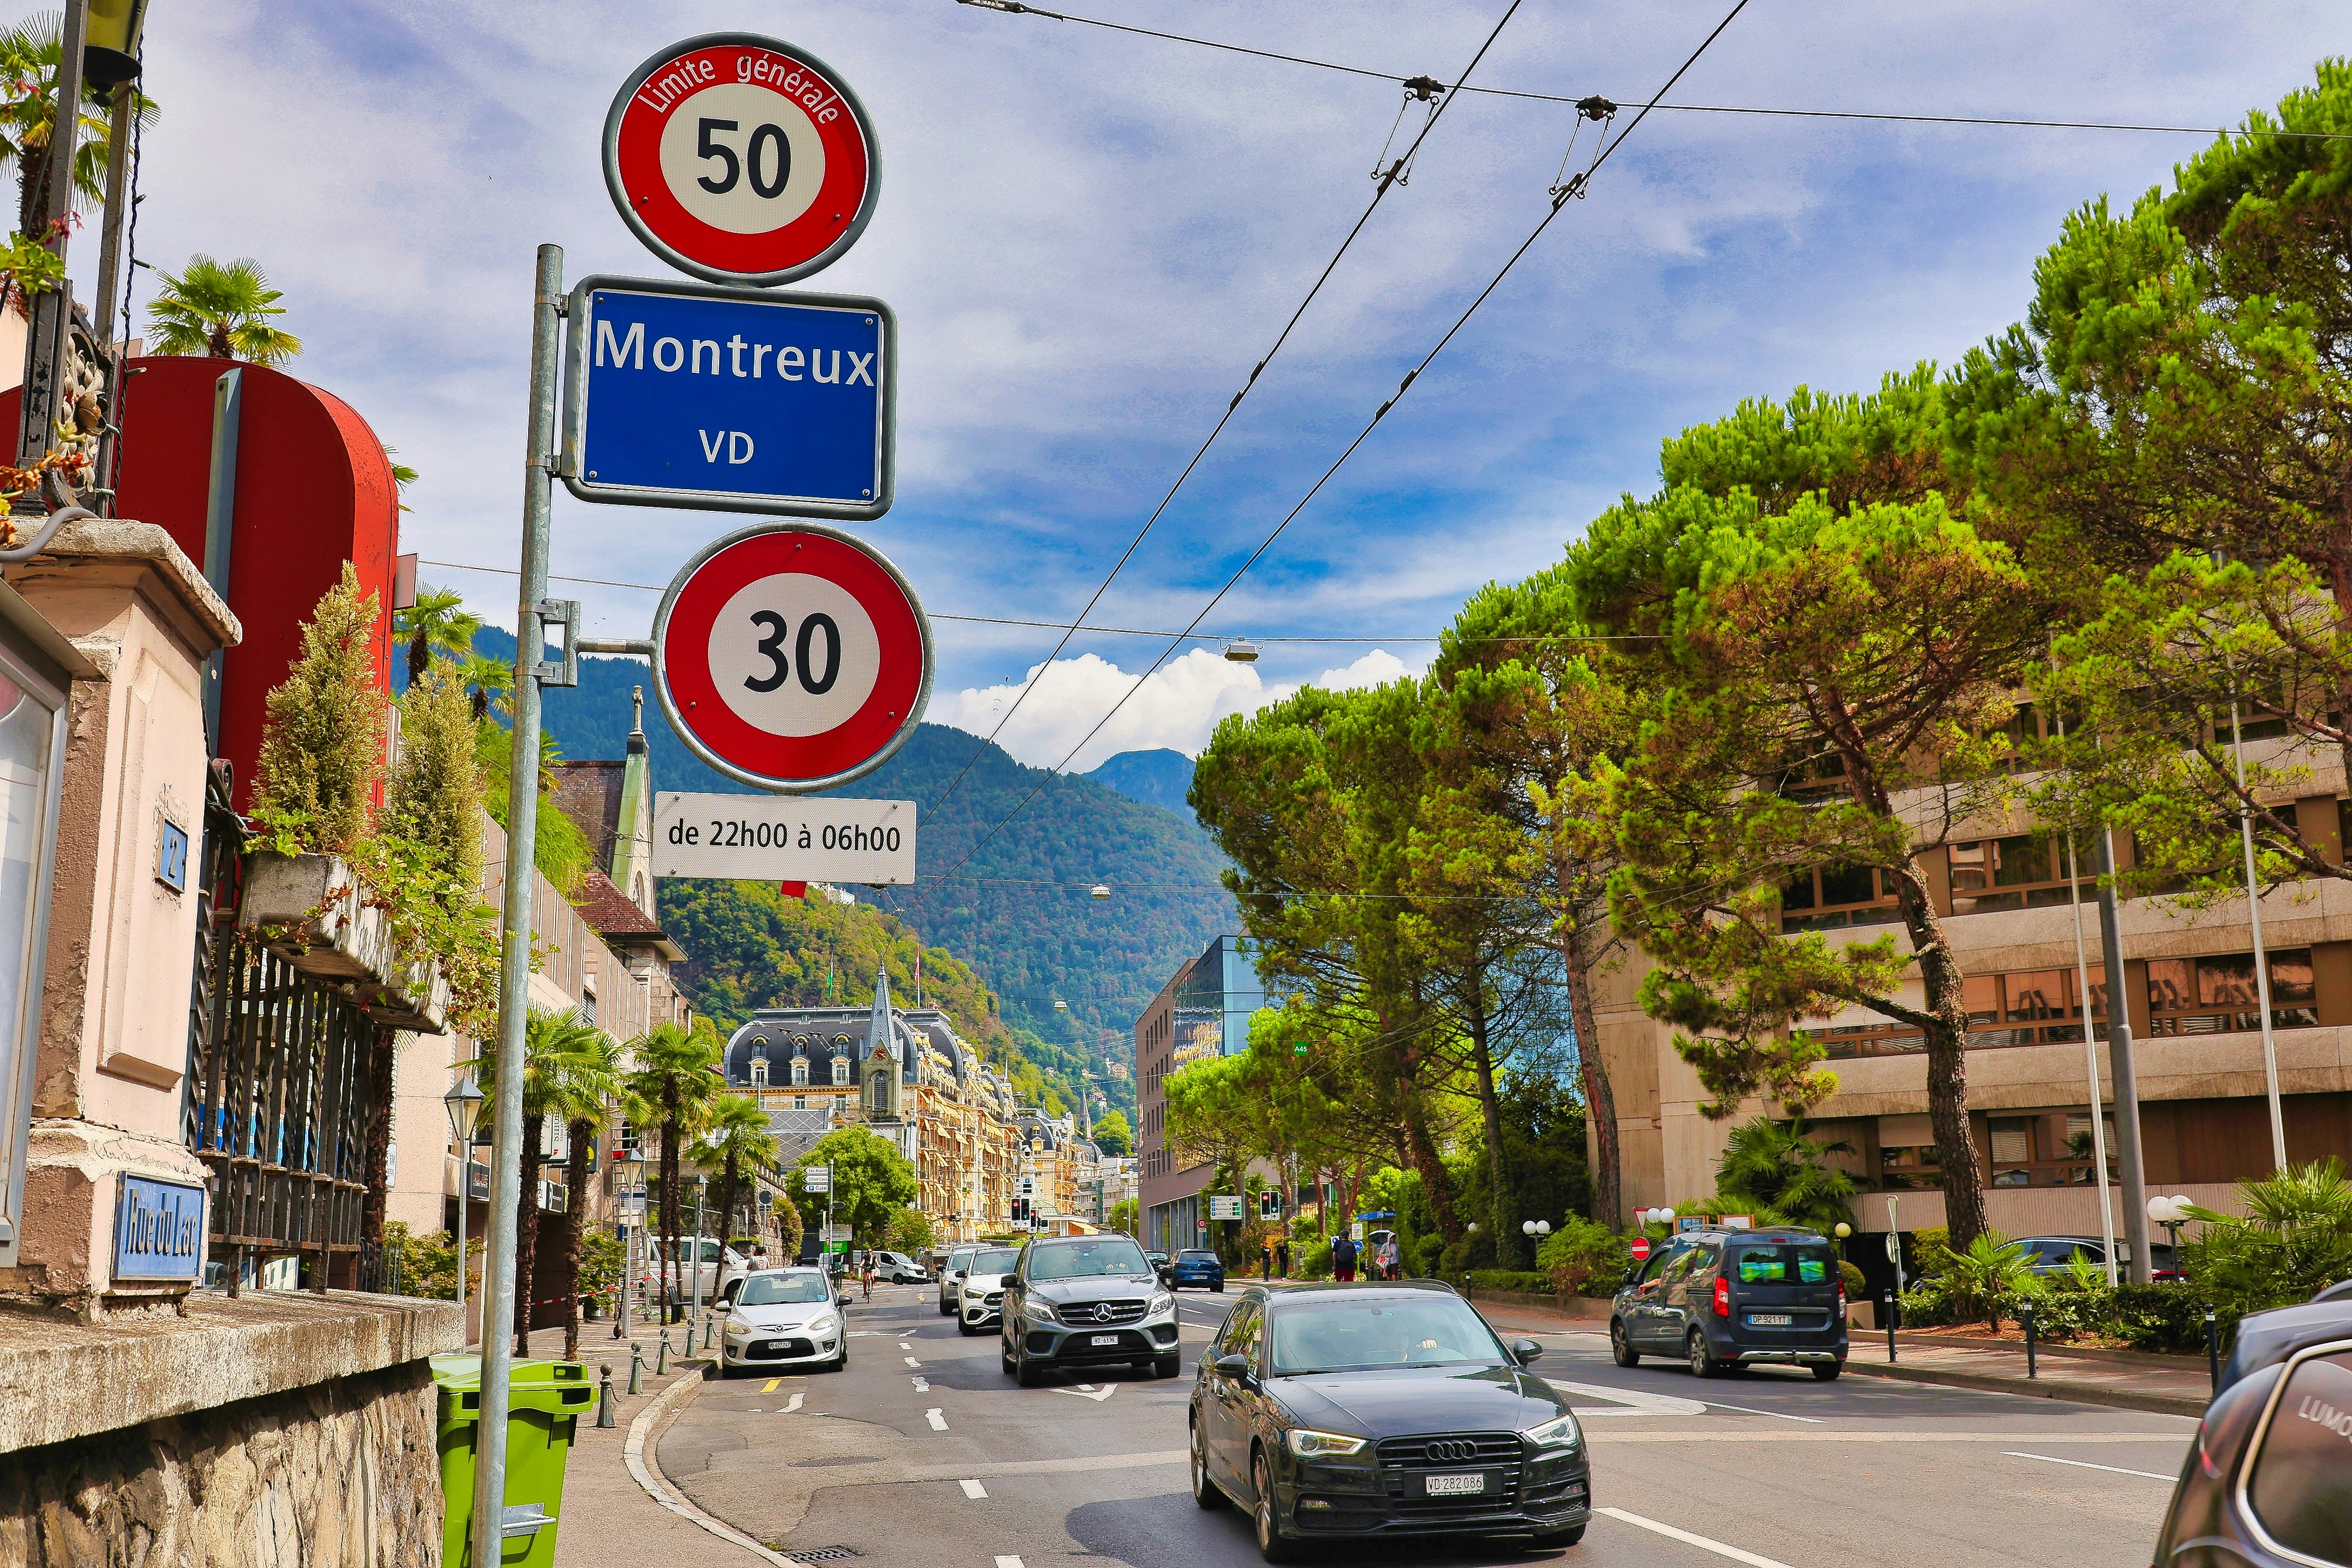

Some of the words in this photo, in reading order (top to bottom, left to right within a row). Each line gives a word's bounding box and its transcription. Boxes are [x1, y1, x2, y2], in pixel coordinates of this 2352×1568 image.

[638, 59, 716, 113] Limite
[737, 54, 838, 124] générale
[696, 116, 791, 199] 50
[595, 320, 874, 386] Montreux
[699, 429, 754, 464] VD
[743, 609, 841, 696] 30
[168, 834, 178, 879] 2
[669, 818, 699, 845] de
[709, 820, 787, 848] 22h00
[798, 823, 811, 850] à
[823, 824, 900, 851] 06h00
[125, 1188, 155, 1255] Rue
[155, 1192, 173, 1256] du
[172, 1195, 198, 1258] Lac
[2298, 1395, 2352, 1445] LUMO
